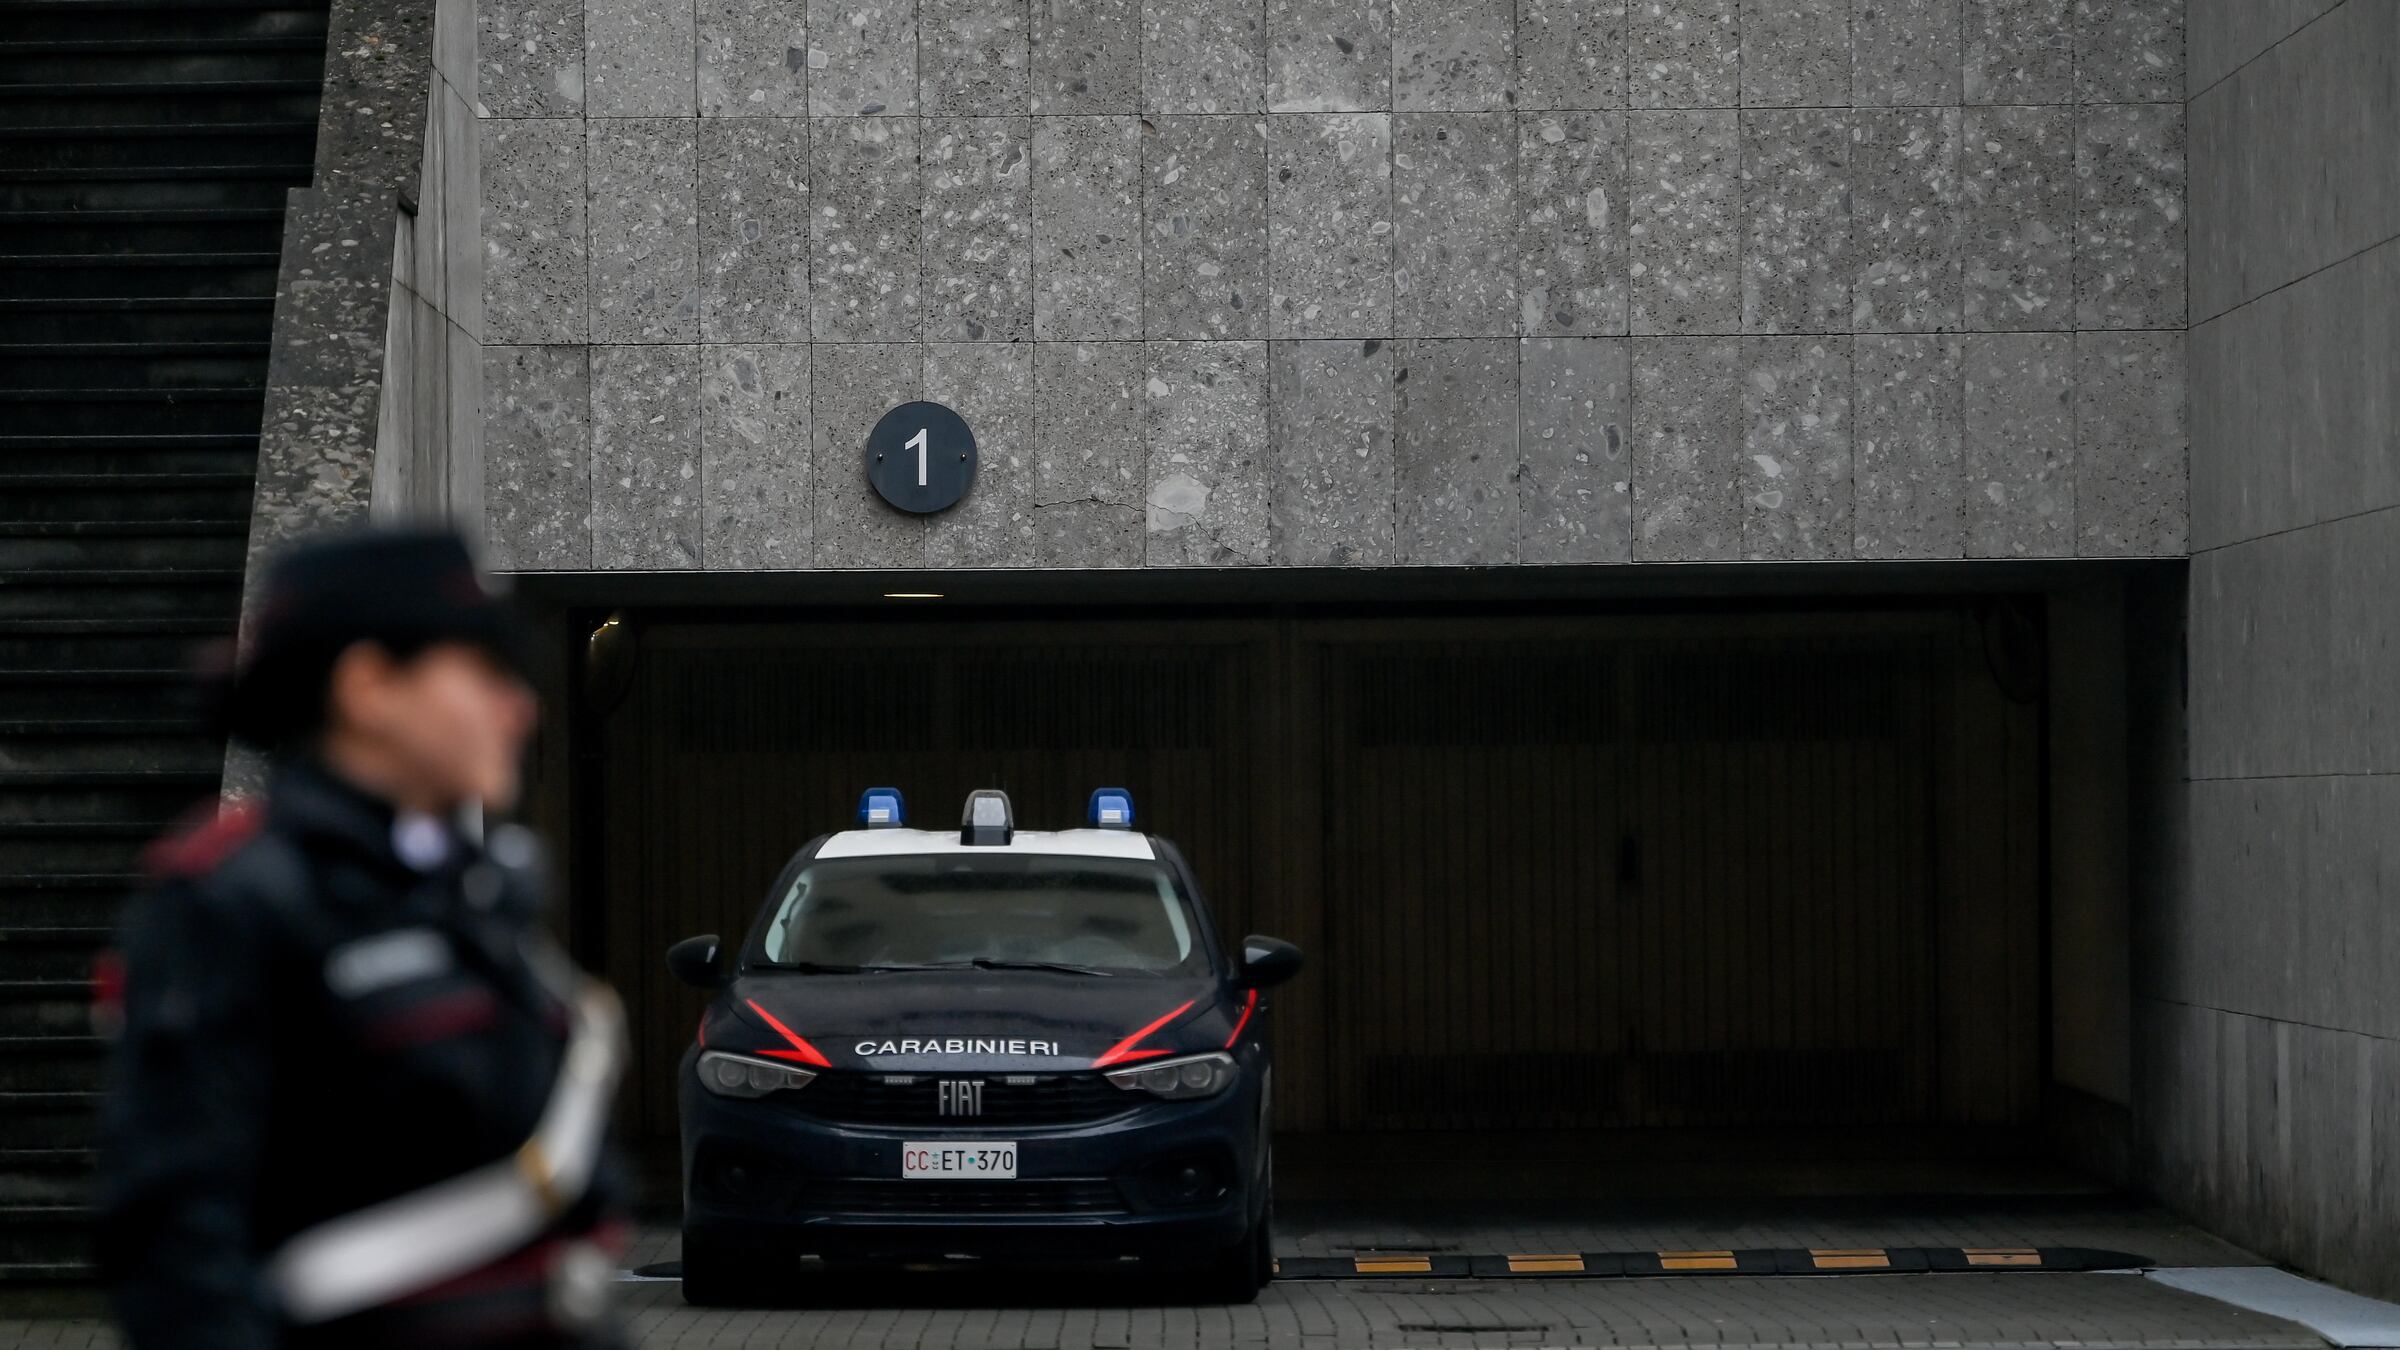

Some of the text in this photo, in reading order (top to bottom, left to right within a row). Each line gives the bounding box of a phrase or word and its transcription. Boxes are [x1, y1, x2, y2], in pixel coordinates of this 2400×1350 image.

[905, 428, 927, 486] 1
[854, 1039, 1059, 1056] CARABINIERI
[938, 1080, 985, 1116] FIAT
